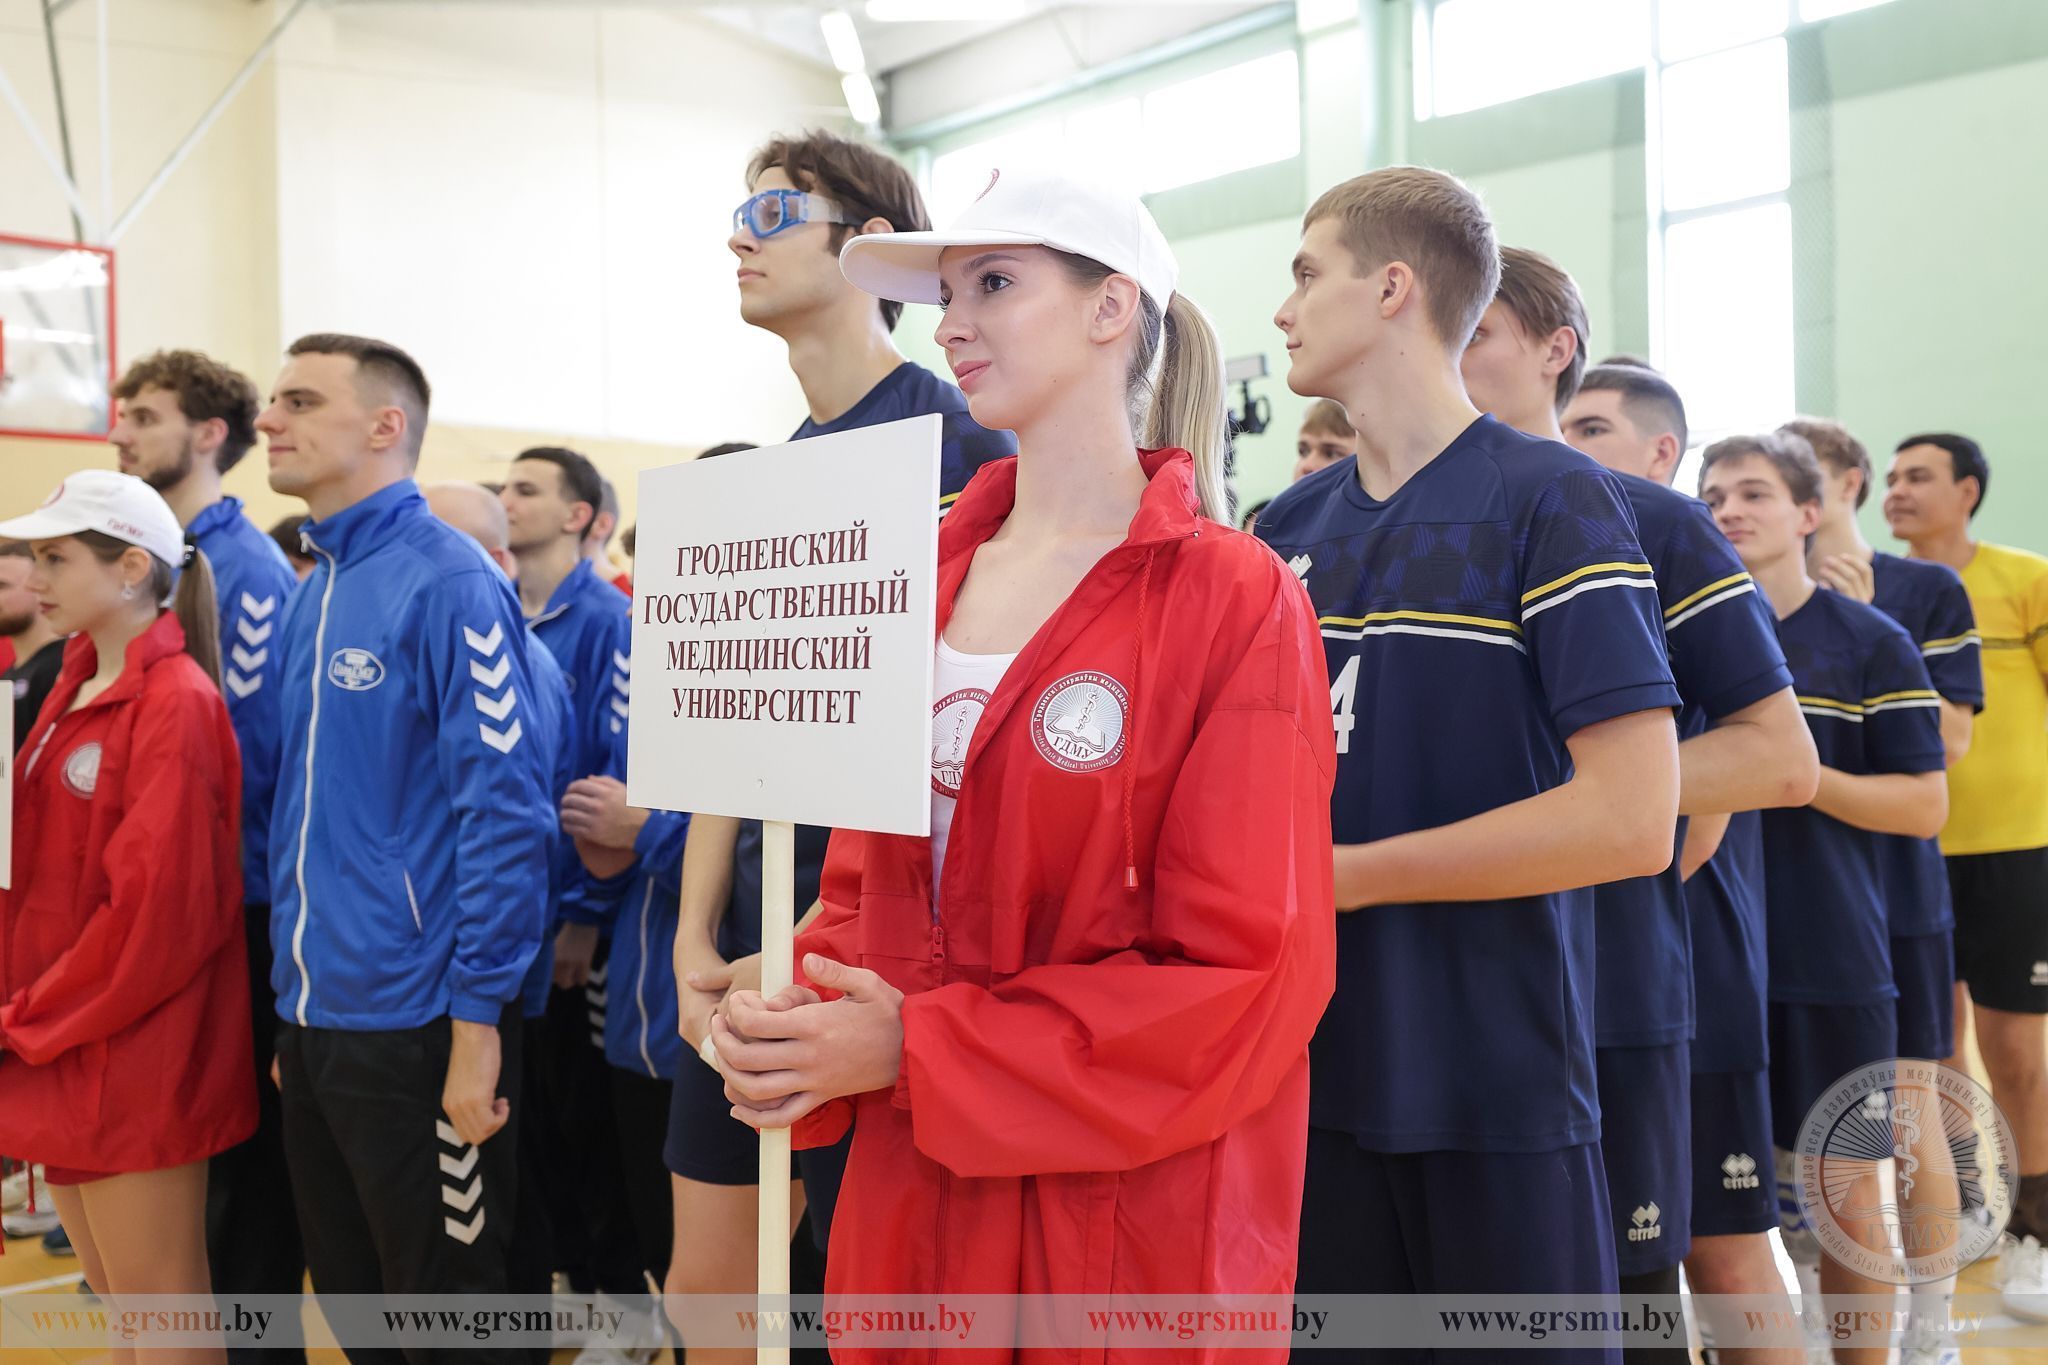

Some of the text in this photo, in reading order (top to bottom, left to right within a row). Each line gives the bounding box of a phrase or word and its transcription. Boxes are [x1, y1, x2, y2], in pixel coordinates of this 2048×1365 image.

[676, 519, 869, 580] ГРОДНЕНСКИЙ
[643, 569, 910, 629] ГОСУДАРСТВЕННЫЙ
[666, 626, 872, 678] МЕДИЦИНСКИЙ
[672, 688, 861, 724] УНИВЕРСИТЕТ
[1053, 736, 1094, 759] ГДМУ
